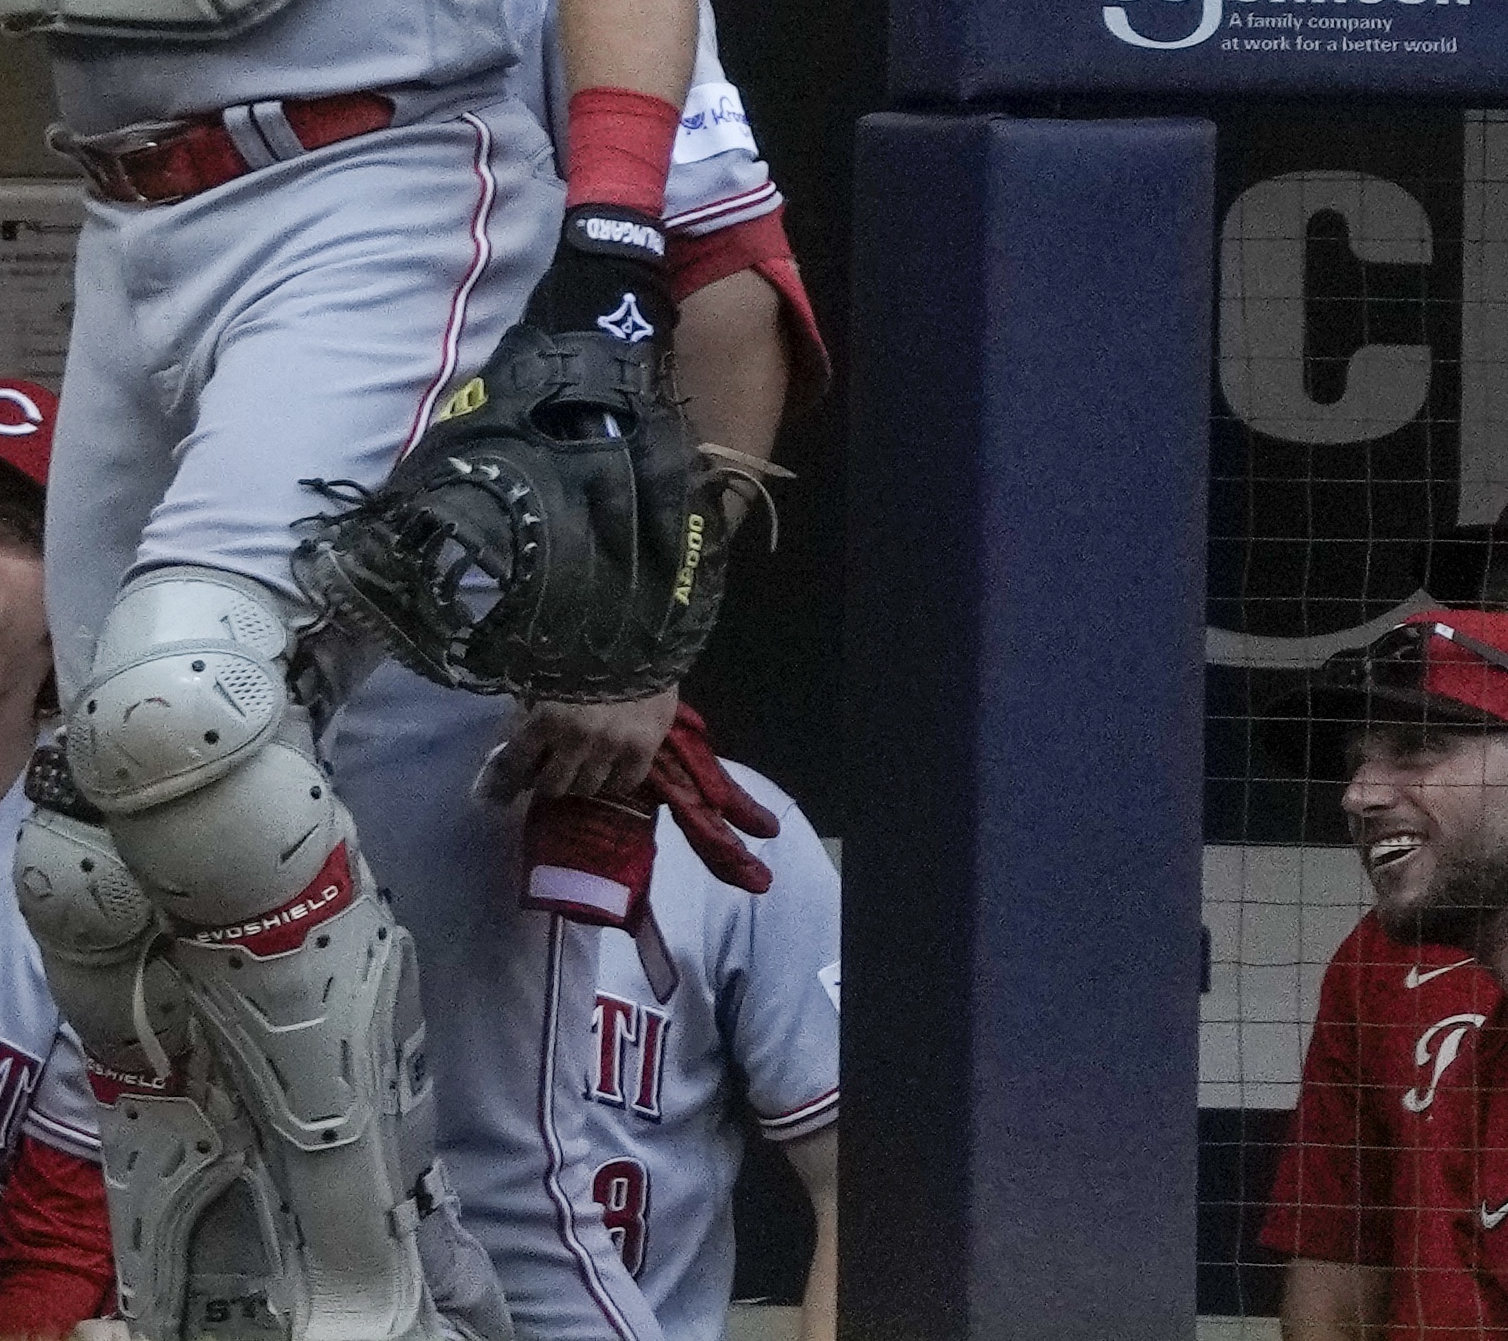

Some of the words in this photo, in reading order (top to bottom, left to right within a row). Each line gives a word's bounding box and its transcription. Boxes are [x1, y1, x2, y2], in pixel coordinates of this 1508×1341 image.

[1229, 13, 1242, 27] A
[1247, 13, 1303, 31] family
[1308, 16, 1393, 32] company
[1221, 38, 1240, 51] at
[1244, 37, 1292, 51] work
[1296, 37, 1322, 51] for
[1327, 40, 1338, 52] a
[1342, 37, 1401, 53] better
[1404, 38, 1458, 53] world
[195, 883, 340, 944] EVOSHIELD
